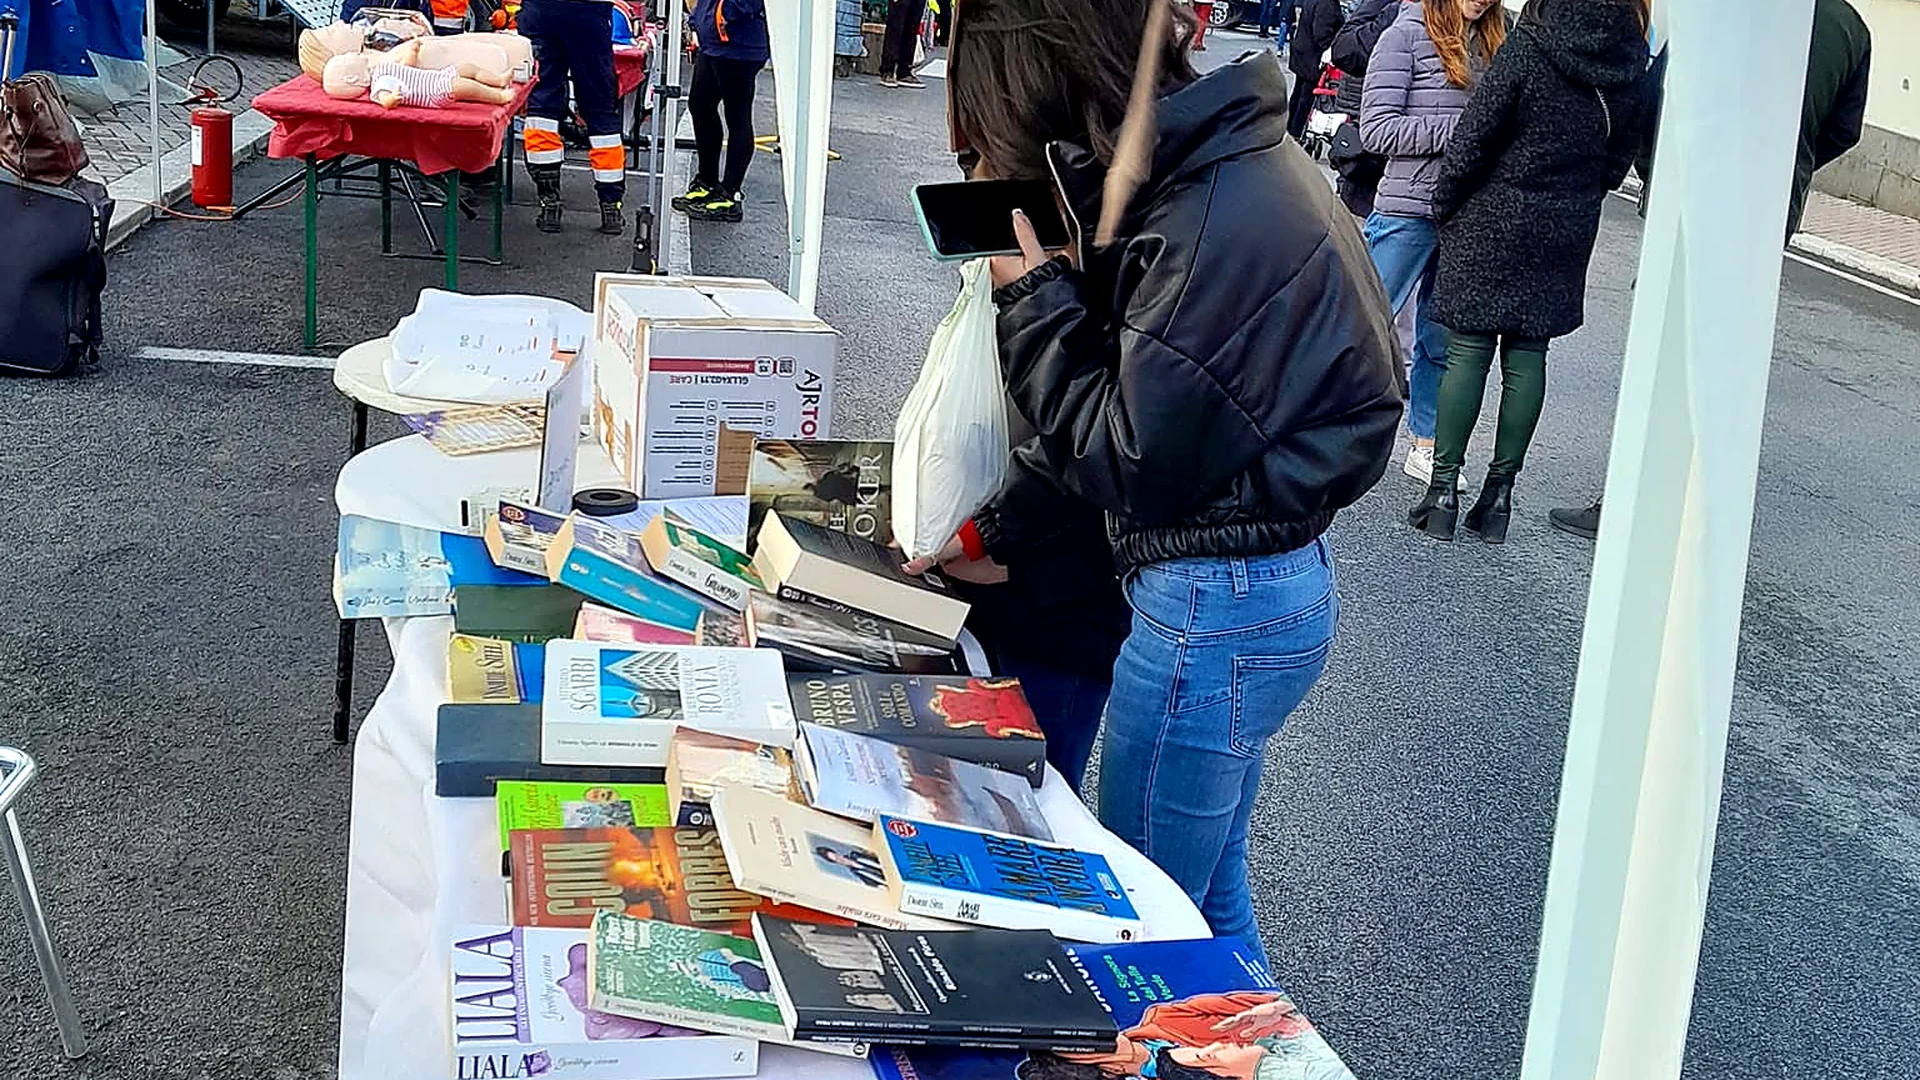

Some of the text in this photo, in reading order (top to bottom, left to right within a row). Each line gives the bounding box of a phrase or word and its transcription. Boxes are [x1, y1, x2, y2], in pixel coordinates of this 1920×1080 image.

[796, 369, 822, 440] AJRTO
[853, 452, 883, 542] OKER
[570, 656, 597, 711] SGARBI
[695, 665, 723, 714] ROMA
[806, 680, 836, 726] BRUNO
[831, 683, 859, 724] VESPA
[891, 683, 917, 727] COMANDO
[540, 840, 626, 917] COLIN
[674, 829, 763, 922] FORBES
[836, 904, 863, 917] madre
[865, 911, 882, 920] cara
[454, 926, 520, 1045] LIALA
[1102, 954, 1132, 990] Signora
[1139, 987, 1158, 1001] del
[457, 1053, 534, 1080] LIALA
